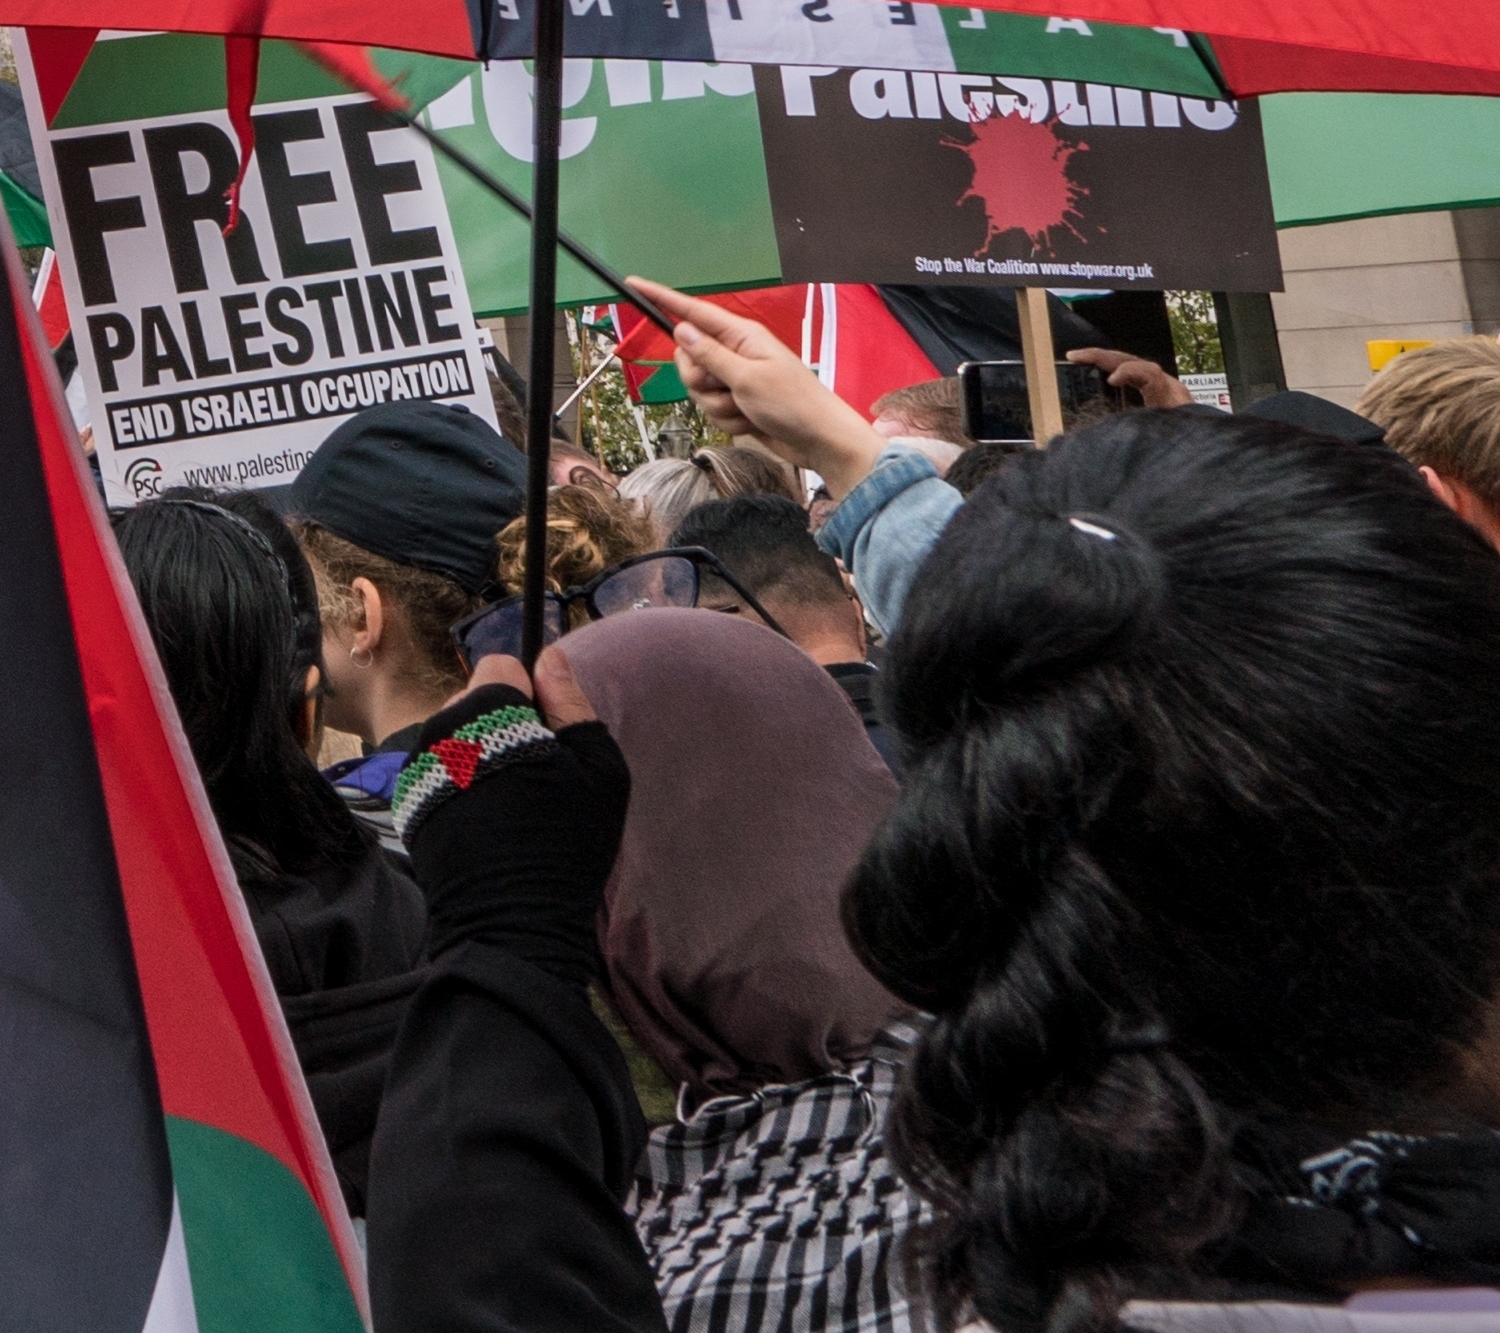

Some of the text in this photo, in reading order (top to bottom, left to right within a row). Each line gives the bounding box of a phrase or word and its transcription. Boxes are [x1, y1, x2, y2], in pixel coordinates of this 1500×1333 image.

[51, 102, 444, 307] FREE
[915, 256, 1155, 281] Stop the War Coalition www.stopwar.org.uk
[85, 265, 462, 393] PALESTINE
[111, 401, 174, 446] END
[182, 382, 297, 434] ISRAELI
[301, 353, 470, 415] OCCUPATION
[134, 474, 162, 499] PSC
